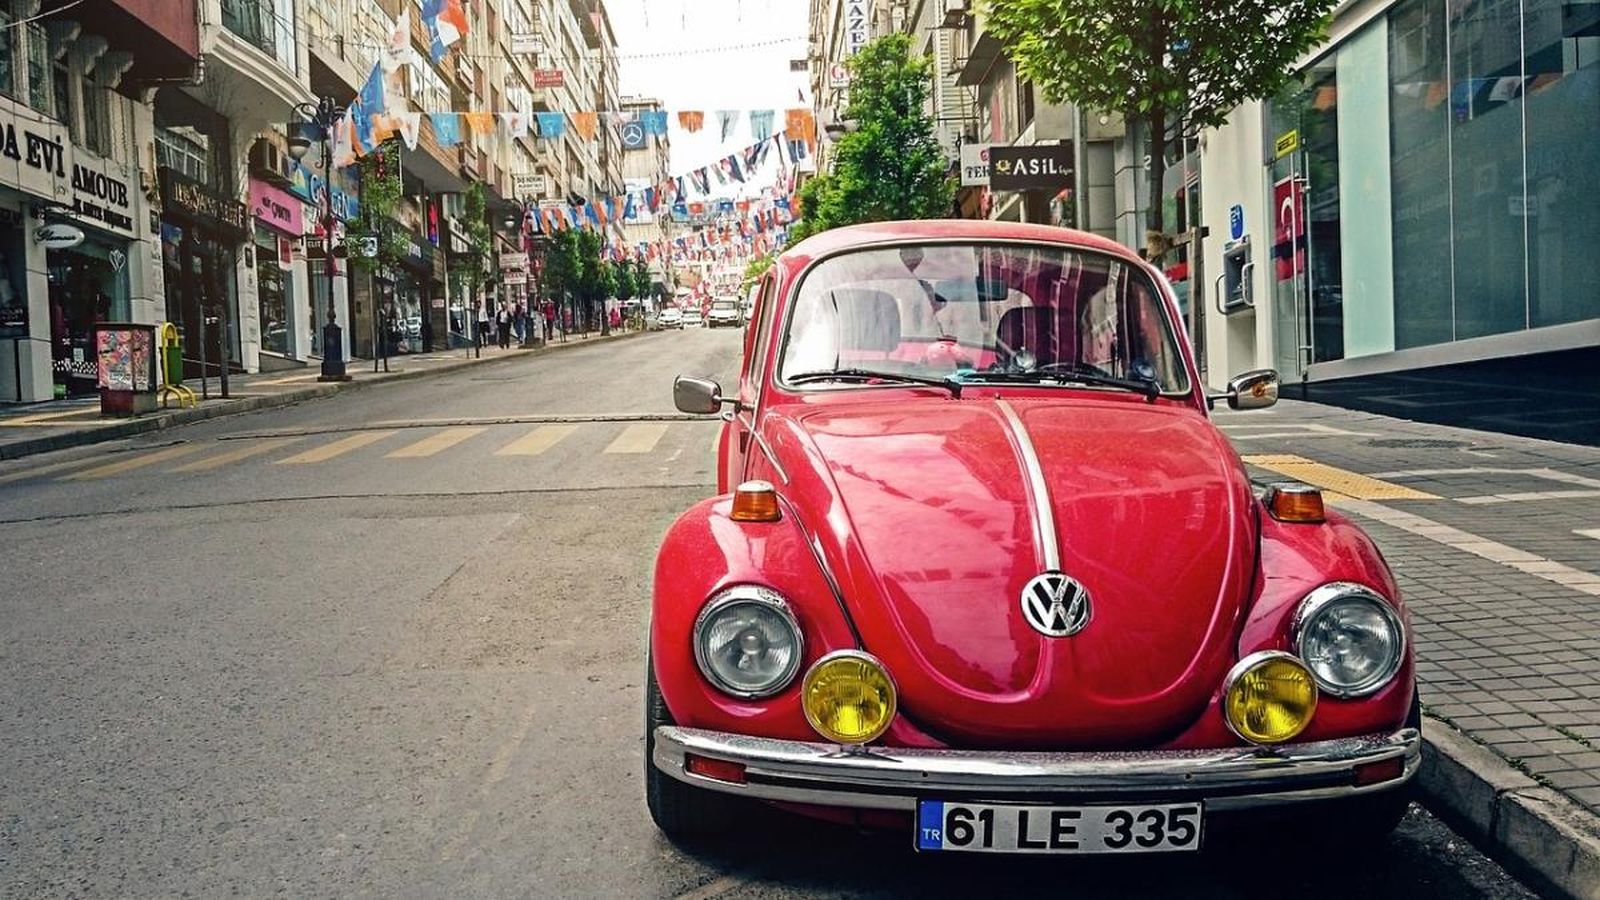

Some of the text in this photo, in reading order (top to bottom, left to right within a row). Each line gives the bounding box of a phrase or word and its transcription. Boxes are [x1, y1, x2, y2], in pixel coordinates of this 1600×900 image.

[0, 122, 65, 178] A EVİ
[71, 164, 128, 209] AMOUR
[1021, 573, 1093, 637] VW
[922, 806, 1198, 849] TR 61 LE 335
